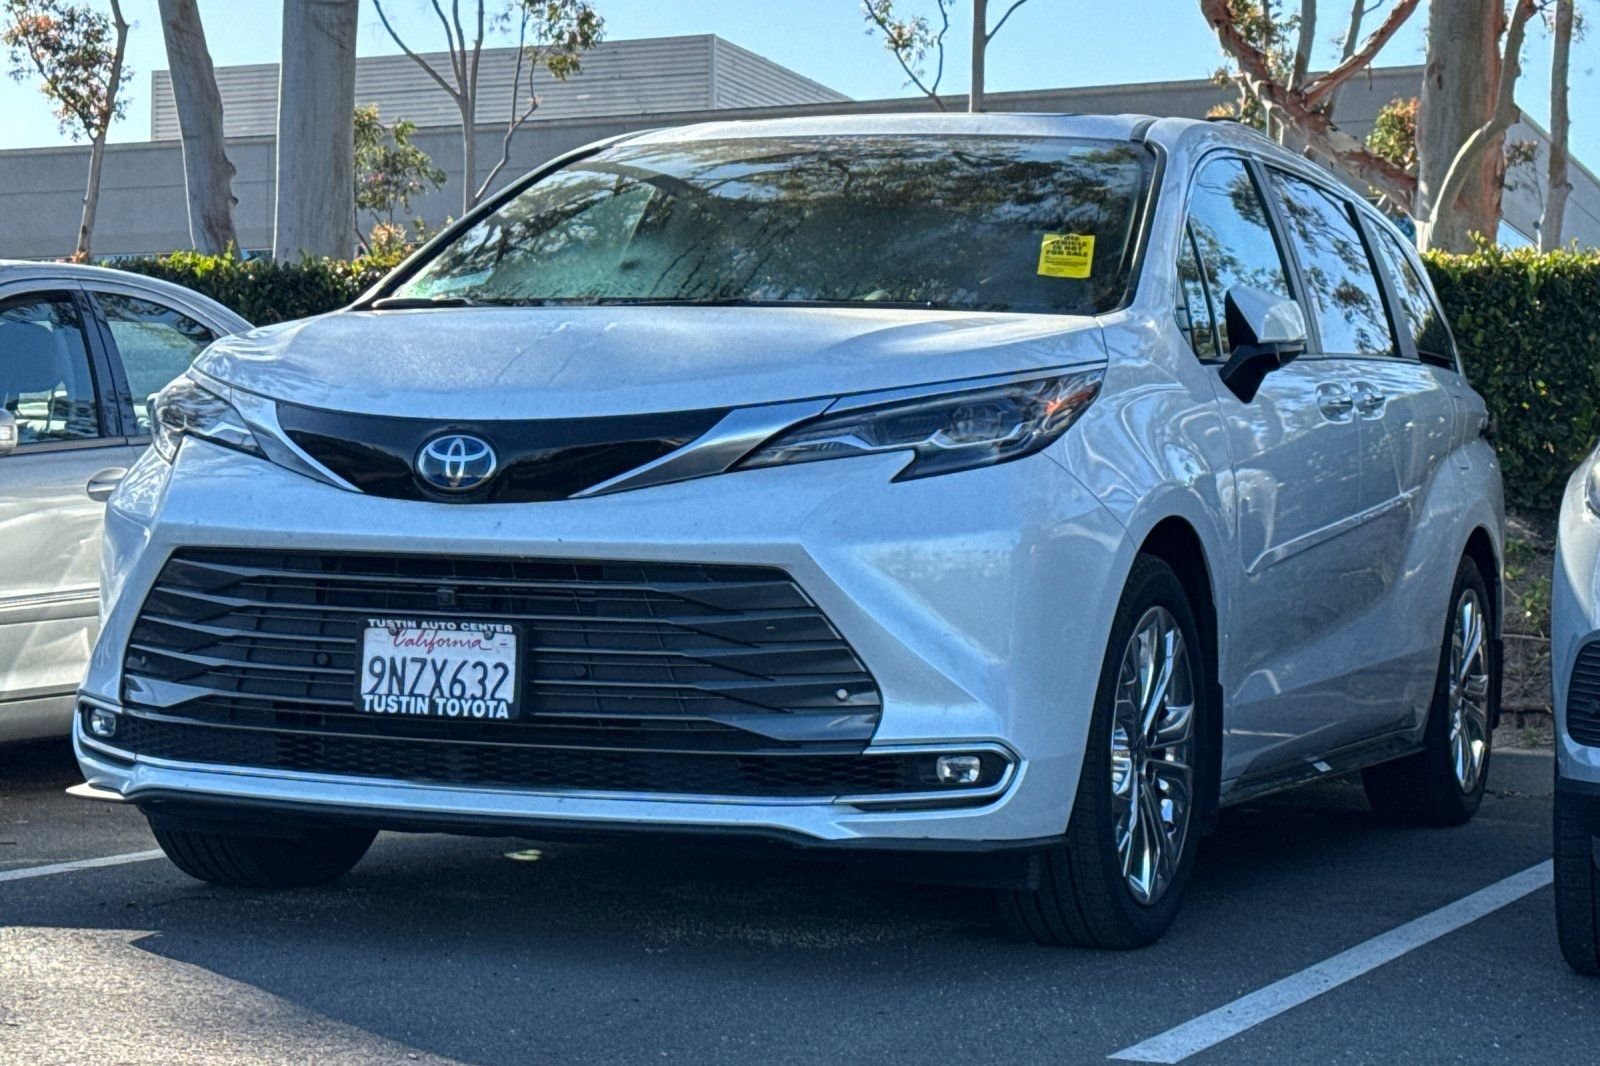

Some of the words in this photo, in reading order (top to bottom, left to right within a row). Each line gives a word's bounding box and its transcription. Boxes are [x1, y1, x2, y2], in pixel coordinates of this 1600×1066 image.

[368, 618, 417, 629] TUSTIN
[421, 621, 457, 631] AUTO
[461, 623, 513, 633] CENTER
[393, 629, 492, 654] California
[368, 655, 509, 700] 9NZX632
[362, 694, 430, 715] TUSTIN
[435, 697, 509, 719] TOYOTA
